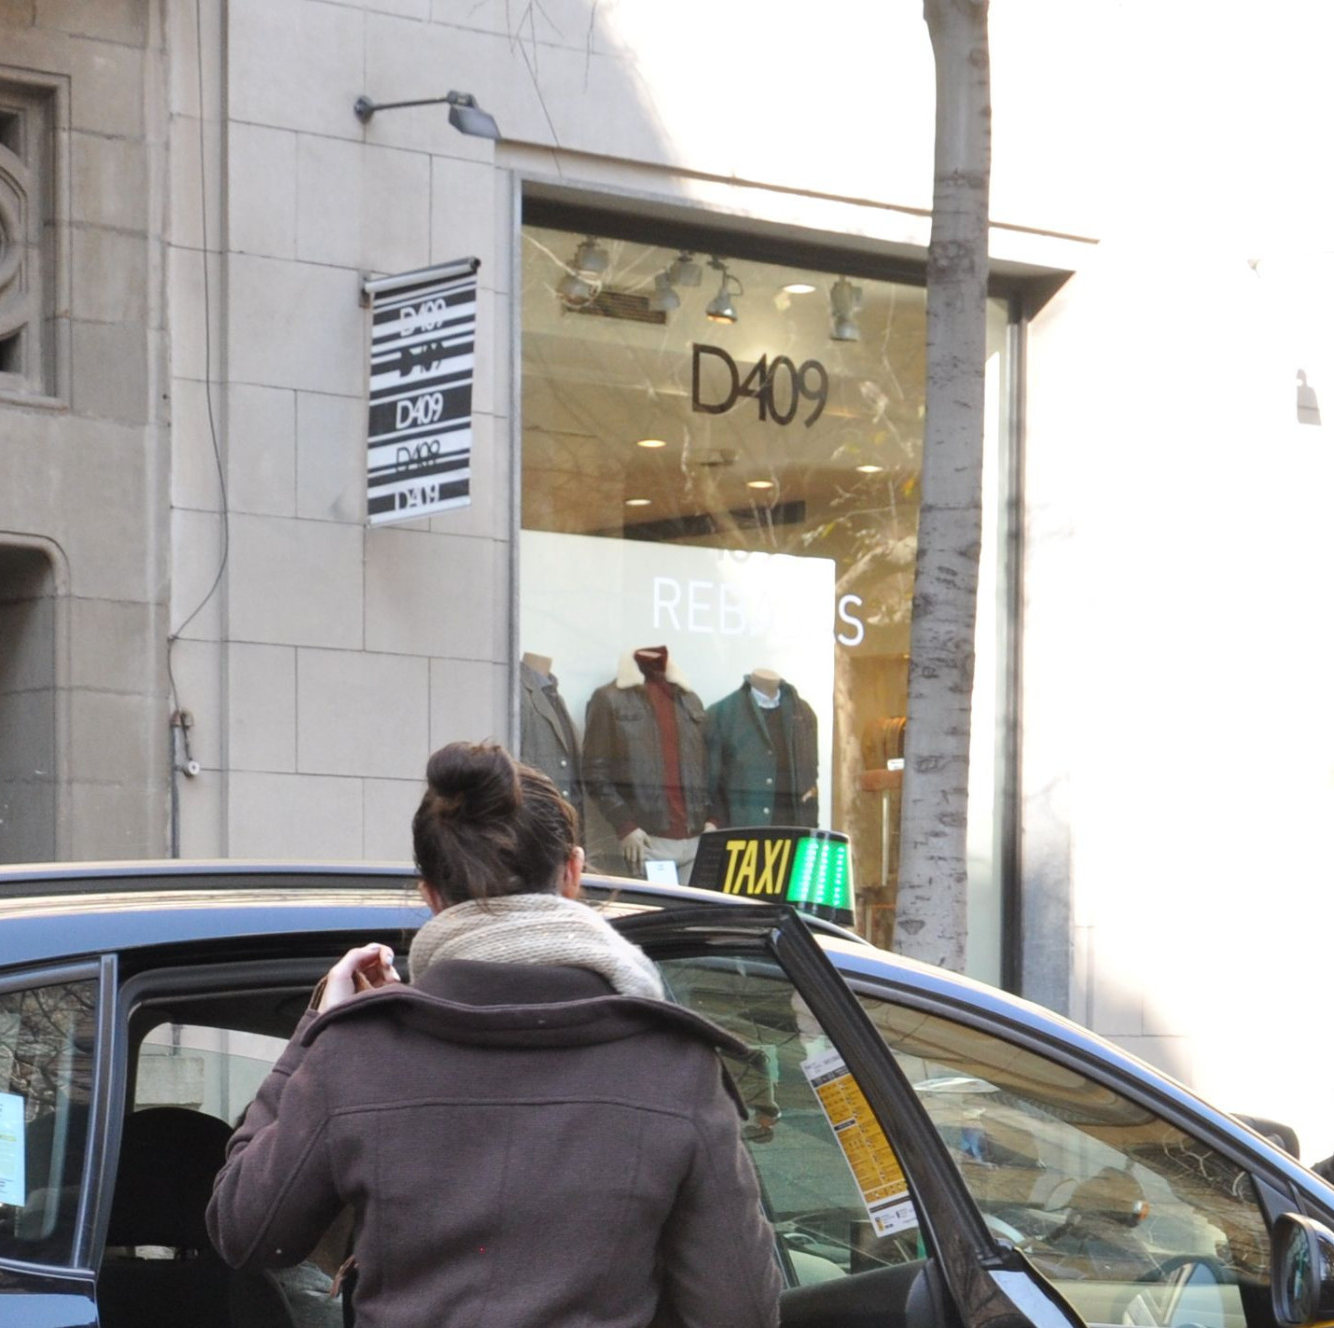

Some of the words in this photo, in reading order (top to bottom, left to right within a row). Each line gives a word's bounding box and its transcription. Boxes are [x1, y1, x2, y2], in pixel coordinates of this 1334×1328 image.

[395, 392, 444, 430] D409
[692, 342, 829, 428] D409
[722, 838, 792, 895] TAXI
